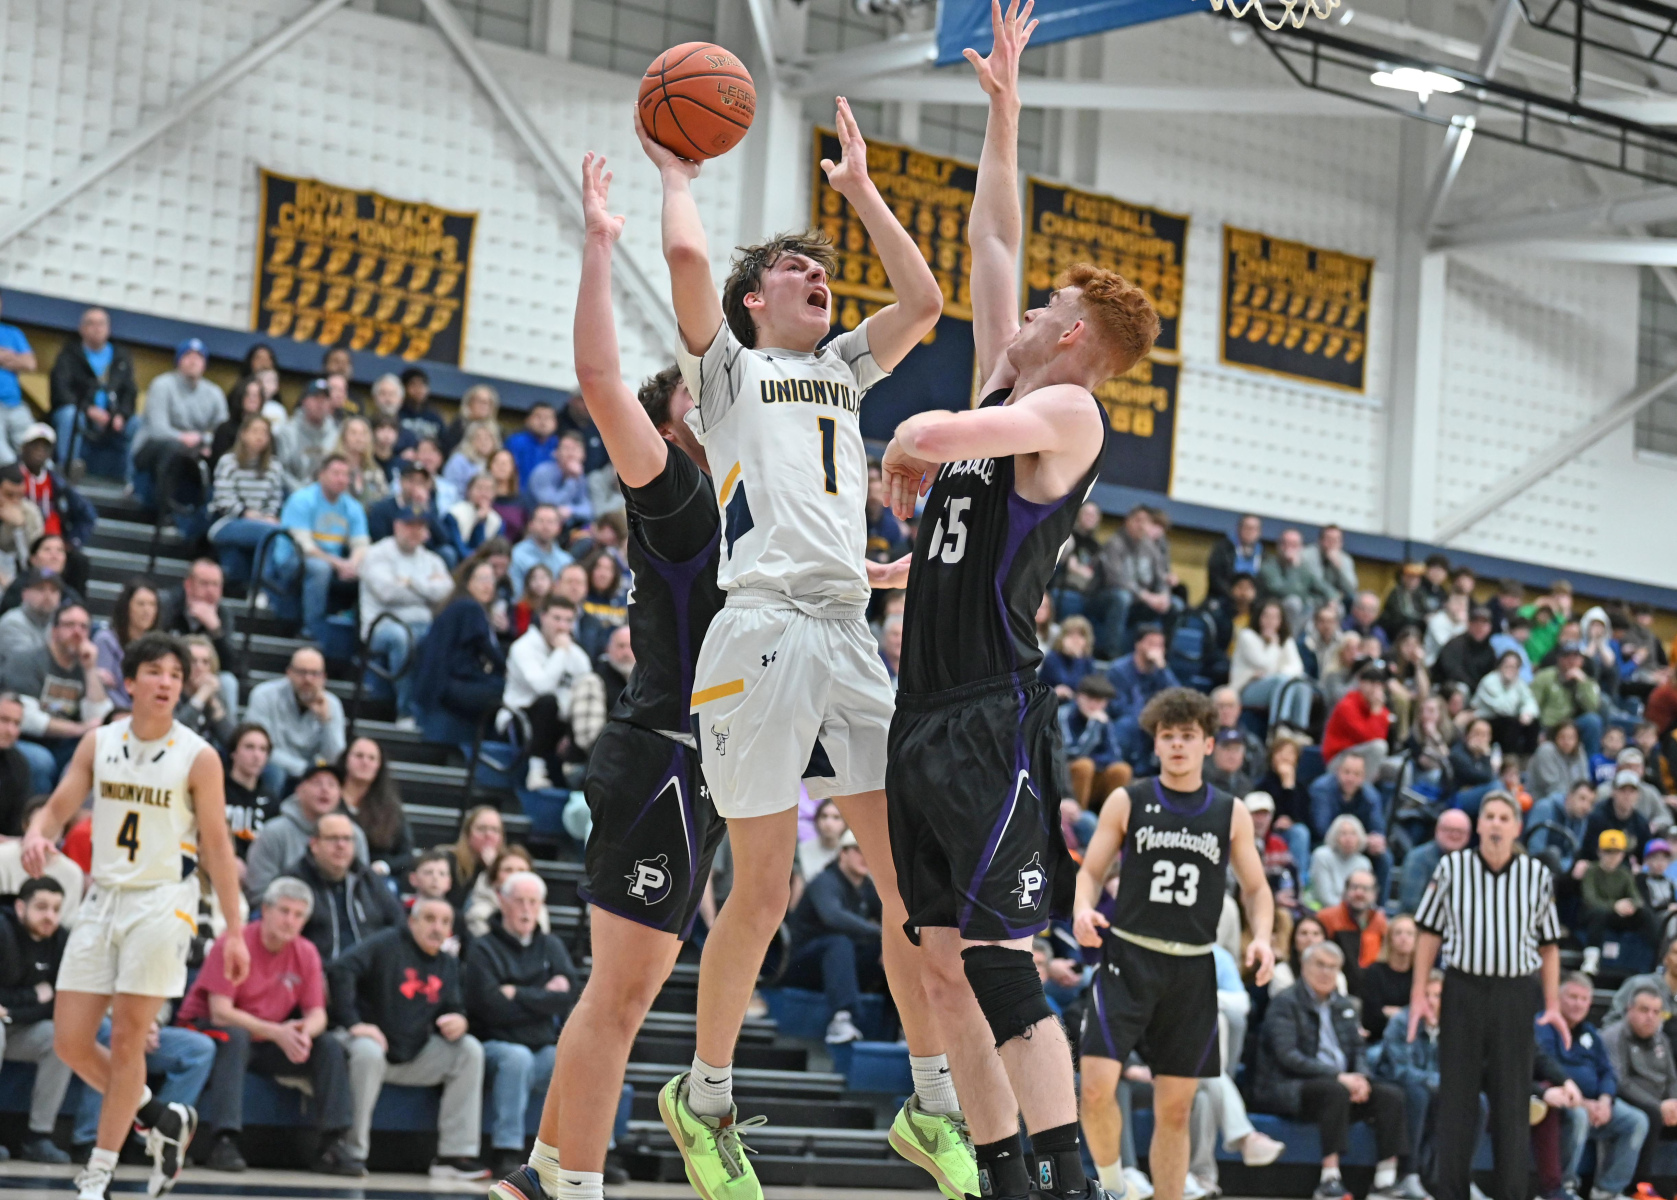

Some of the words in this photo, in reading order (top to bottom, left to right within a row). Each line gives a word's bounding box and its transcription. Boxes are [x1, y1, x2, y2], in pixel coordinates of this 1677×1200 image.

[906, 151, 956, 186] GOLF
[296, 184, 357, 217] BOYS
[373, 196, 444, 233] TRACK
[1063, 191, 1156, 236] FOOTBALL
[278, 202, 459, 263] CHAMPIONSHIPS
[1039, 211, 1176, 265] CHAMPIONSHIPS
[816, 415, 838, 496] 1
[100, 781, 173, 808] UNIONVILLE
[117, 810, 141, 863] 4
[1134, 825, 1221, 865] Phoenixville
[629, 862, 667, 898] P
[1019, 868, 1044, 906] P
[1148, 859, 1200, 907] 23
